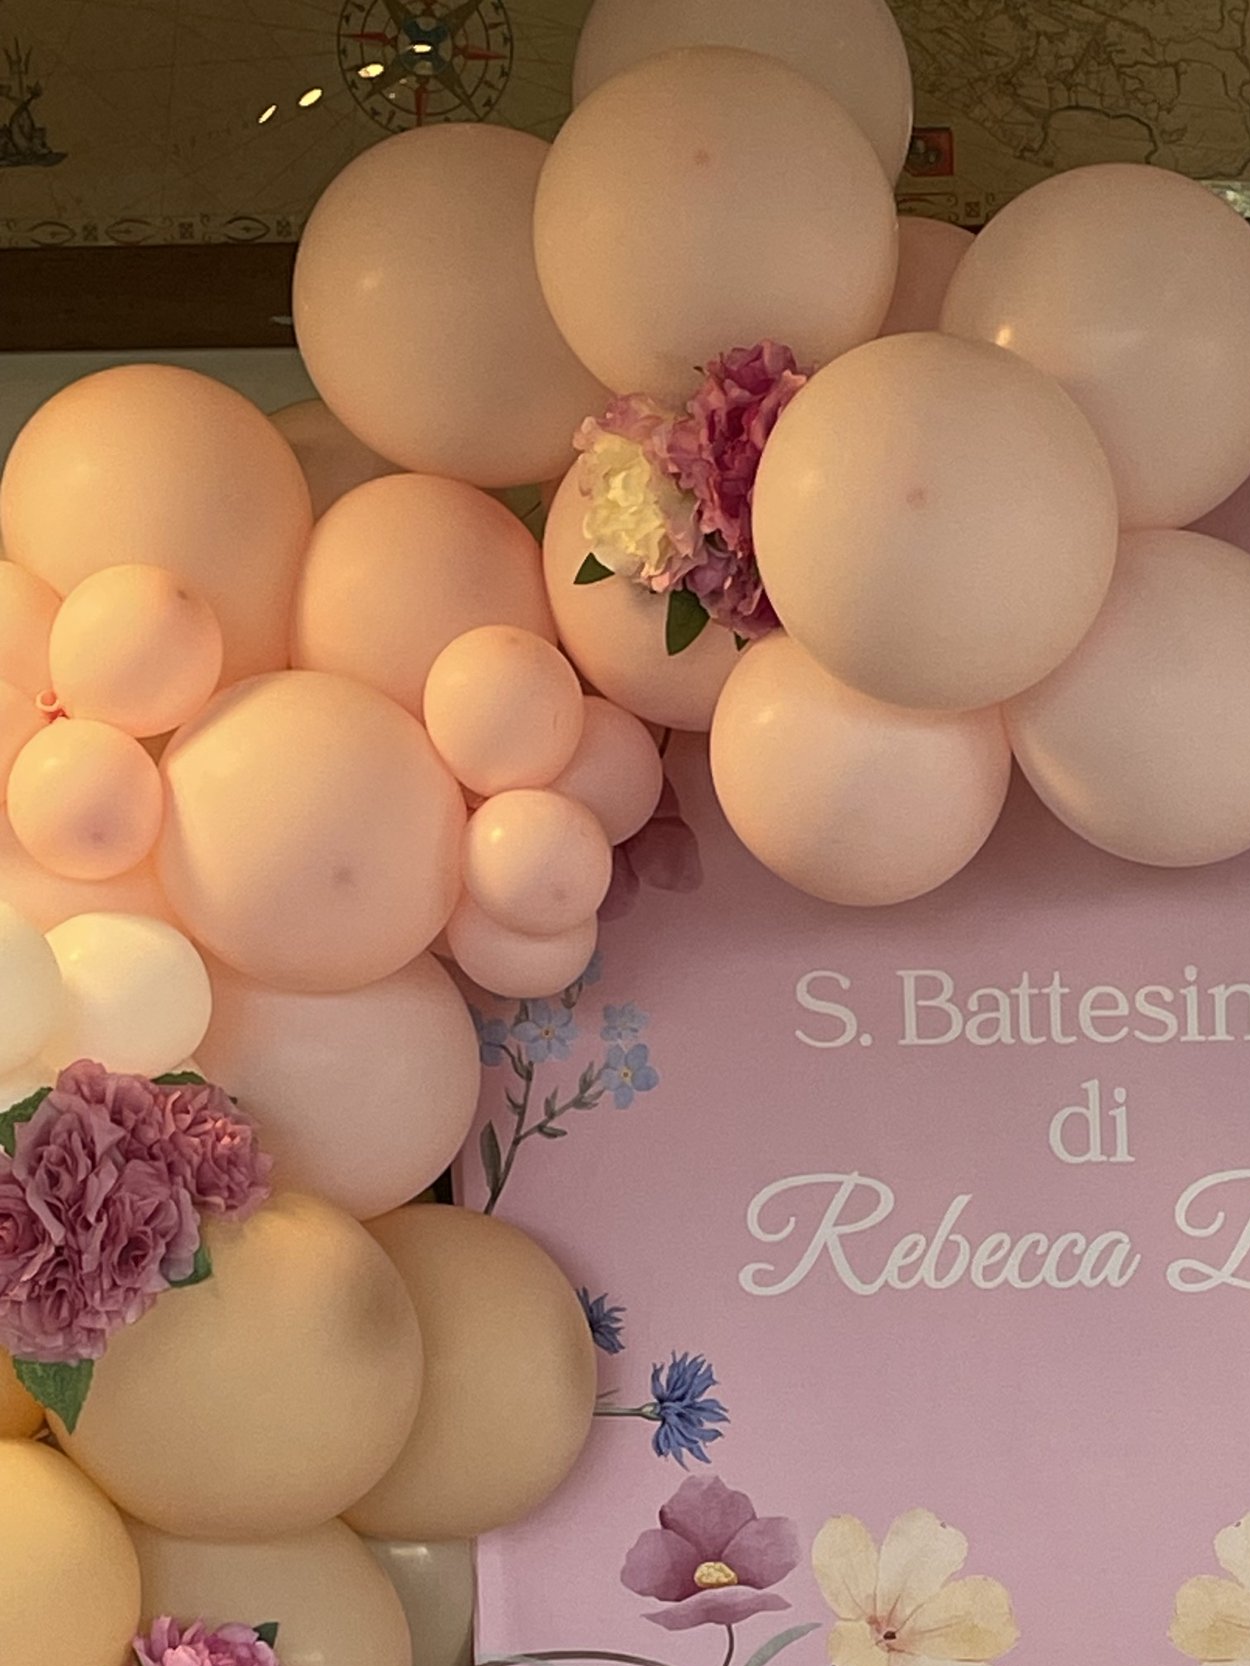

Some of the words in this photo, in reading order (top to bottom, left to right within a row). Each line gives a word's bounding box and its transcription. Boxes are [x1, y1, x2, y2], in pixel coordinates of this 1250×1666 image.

[794, 969, 873, 1049] S.
[1048, 1078, 1136, 1164] di
[738, 1171, 1141, 1296] Rebecca
